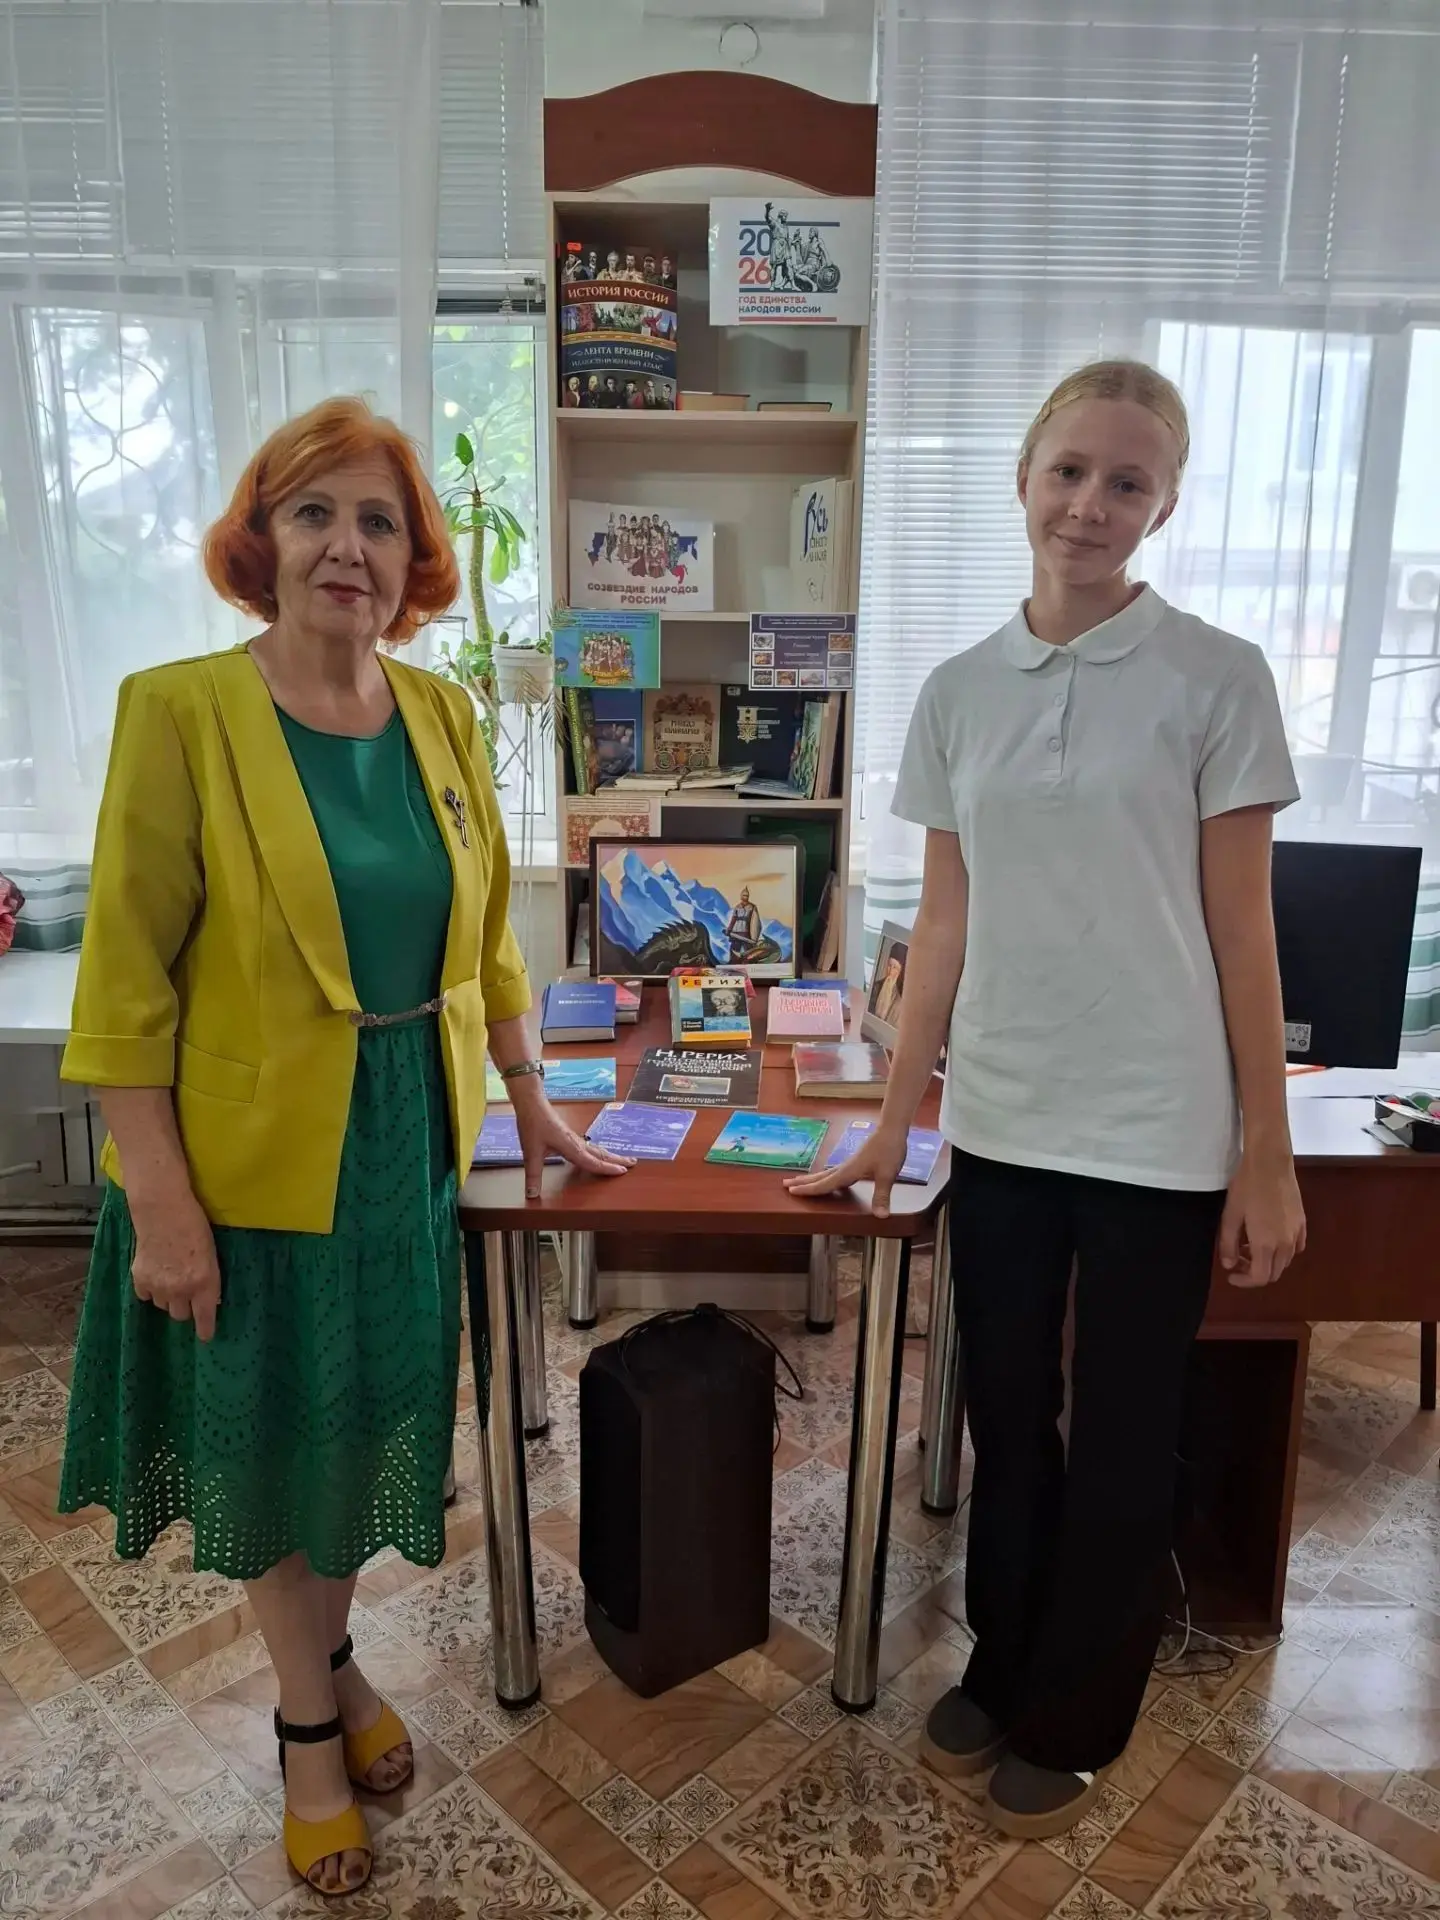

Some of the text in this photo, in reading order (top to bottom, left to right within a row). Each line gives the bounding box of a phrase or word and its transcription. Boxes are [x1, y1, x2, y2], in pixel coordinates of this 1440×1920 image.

[738, 228, 772, 257] 20
[738, 257, 771, 284] 26
[568, 286, 669, 304] ИСТОРИЯ РОССИИ
[739, 296, 807, 304] ГОД ЕДИНСТВА
[739, 305, 822, 313] НАРОДОВ РОССИИ
[584, 346, 654, 359] ЛЕНТА ВРЕМЕНИ
[587, 582, 699, 595] СОЗВЕЗДИЕ НАРОДОВ
[620, 595, 667, 604] РОССИИ
[681, 978, 742, 986] РЕРИХ
[655, 1049, 748, 1061] Н. РЕРИХ
